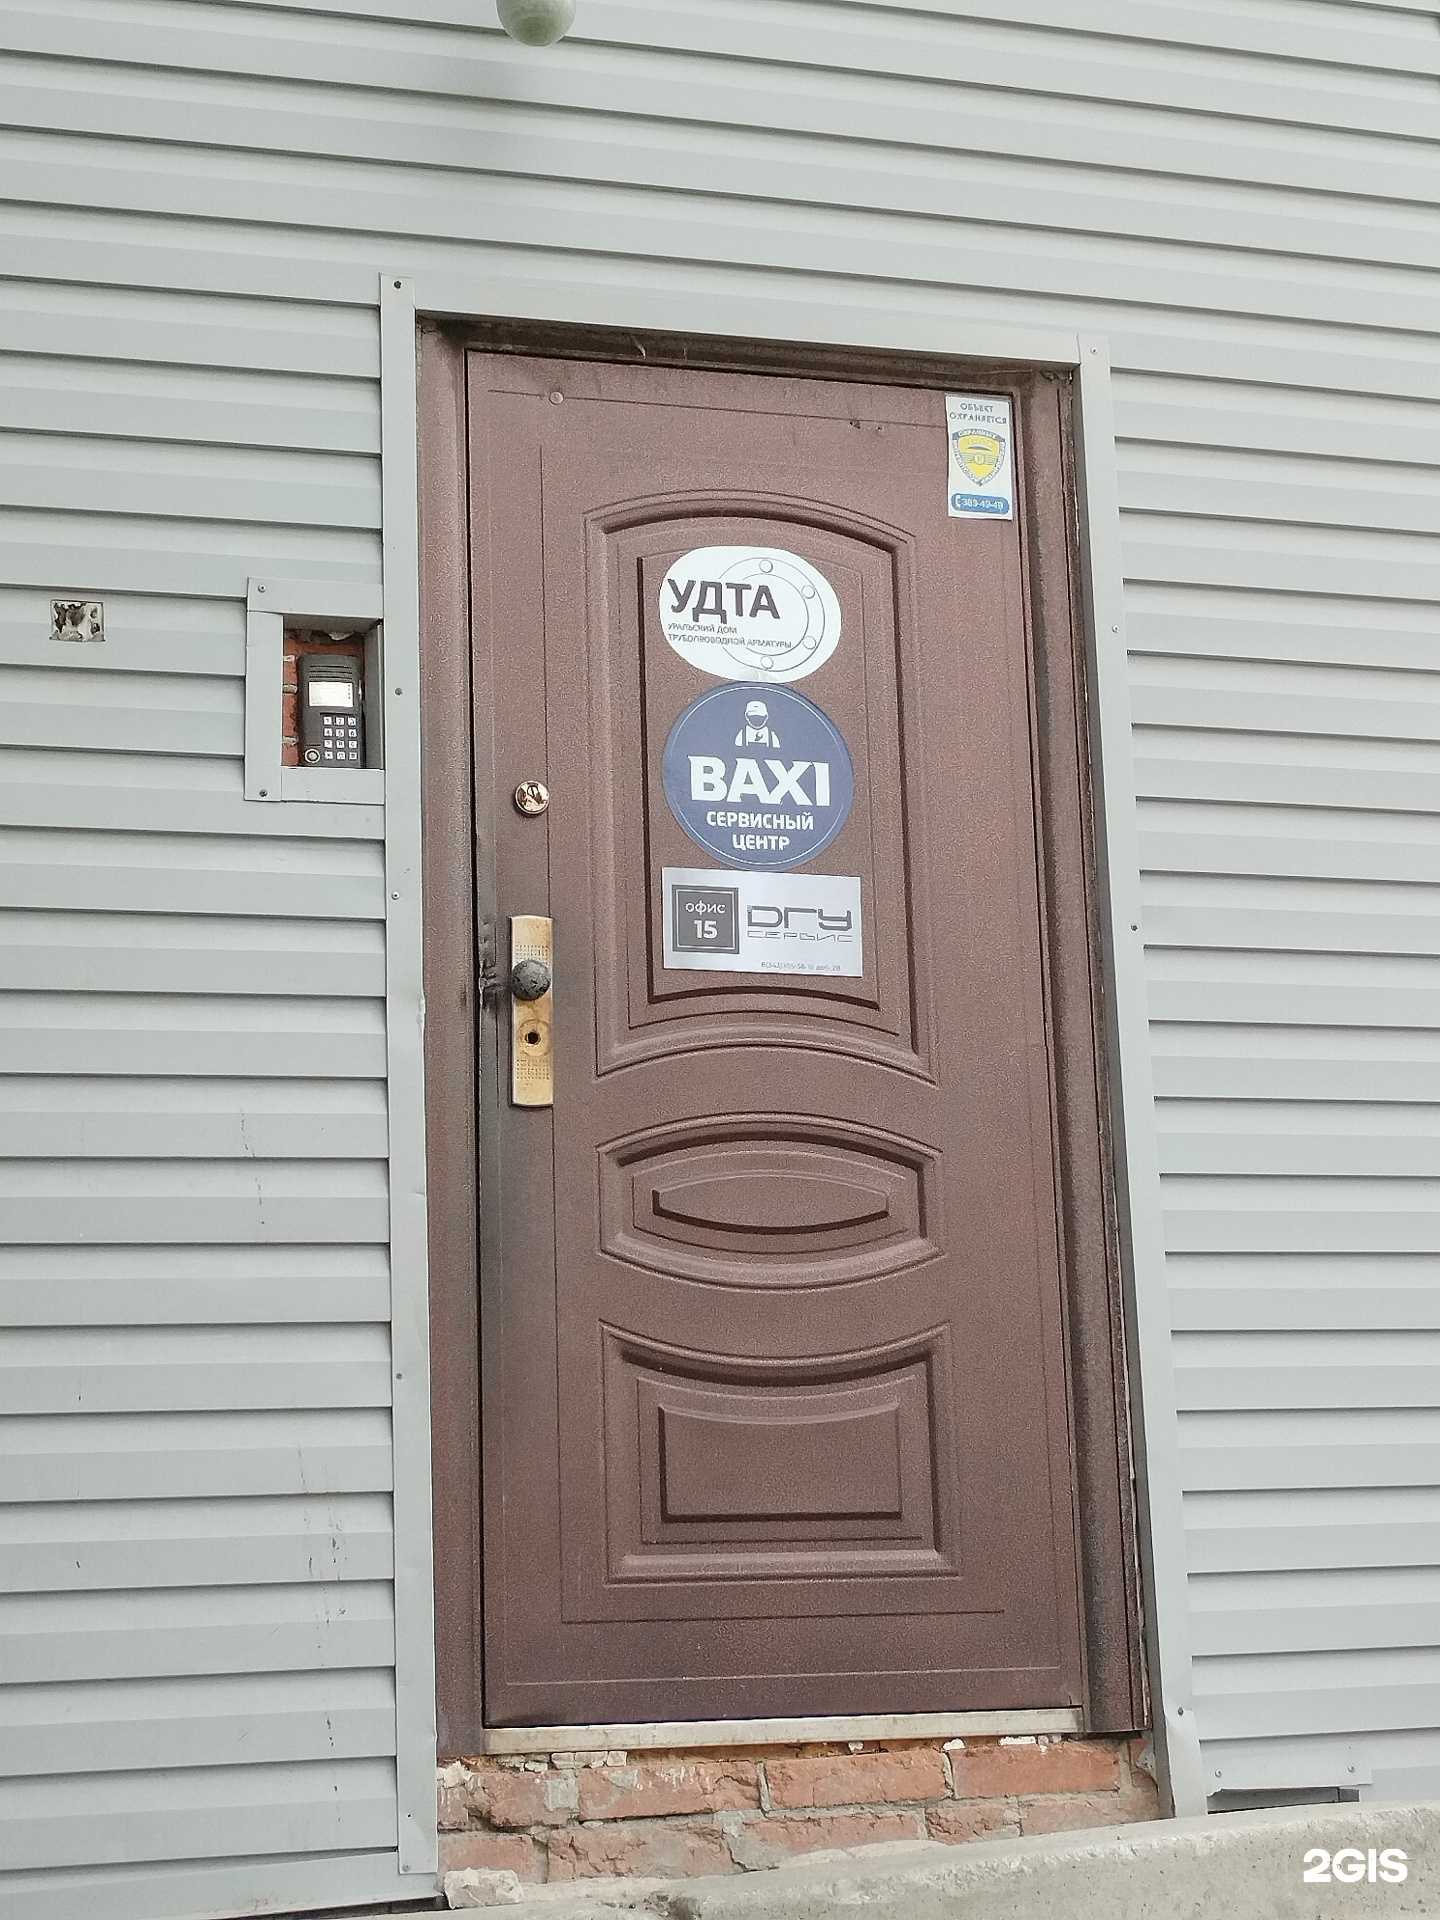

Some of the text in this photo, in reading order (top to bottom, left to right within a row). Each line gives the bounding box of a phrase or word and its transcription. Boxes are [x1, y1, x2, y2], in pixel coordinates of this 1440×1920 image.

[960, 402, 993, 413] ОБЪЕКТ
[949, 411, 1007, 425] ОХРАНЯЕТСЯ
[667, 578, 780, 624] УДТА
[668, 622, 737, 634] УРАЛЬСКИЙ ДОМ
[668, 633, 793, 649] ТРУБОПРОВОДНОЙ АРМАТУРЫ
[687, 755, 830, 807] BAXI
[706, 811, 814, 830] СЕРВИСНЫЙ
[732, 833, 790, 851] ЦЕНТР
[693, 919, 718, 940] 15
[747, 930, 853, 943] СЕРВИС
